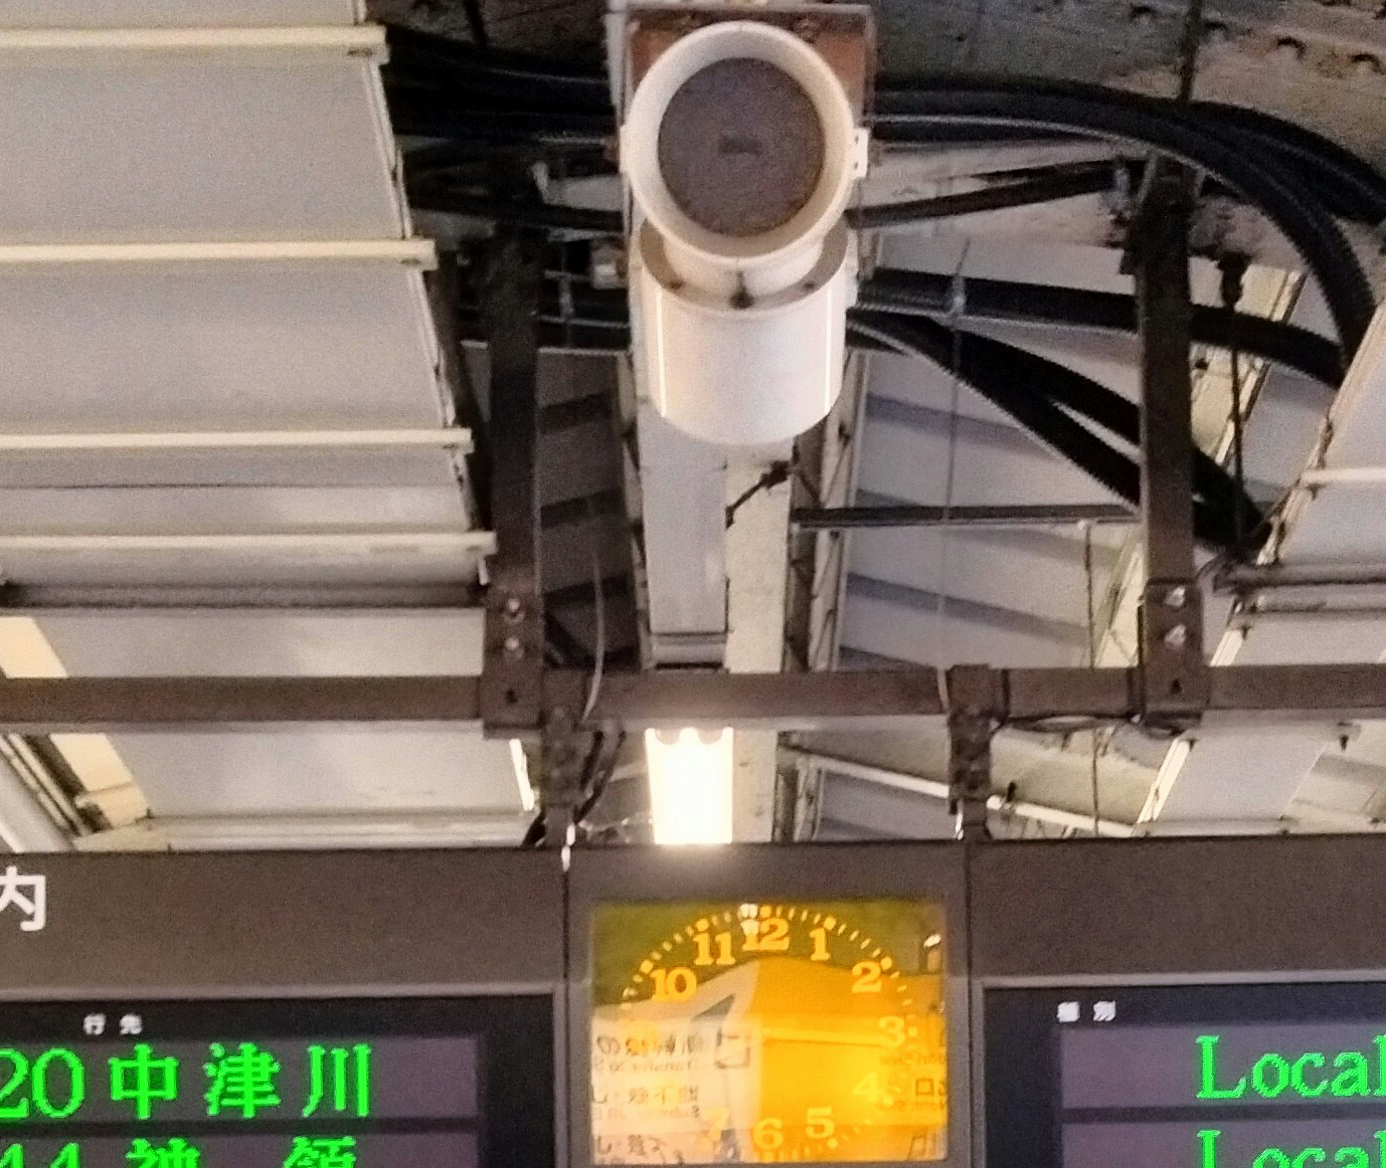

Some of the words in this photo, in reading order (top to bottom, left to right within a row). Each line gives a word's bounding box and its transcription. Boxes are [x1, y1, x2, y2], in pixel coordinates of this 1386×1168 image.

[693, 931, 735, 966] 11
[742, 918, 790, 951] 12
[809, 926, 831, 961] 1
[651, 967, 697, 1001] 10
[851, 961, 883, 993] 2
[878, 1016, 907, 1048] 3
[109, 1044, 373, 1120] 中津川
[853, 1072, 885, 1102] 4
[753, 1118, 784, 1151] 6
[805, 1107, 835, 1140] 5
